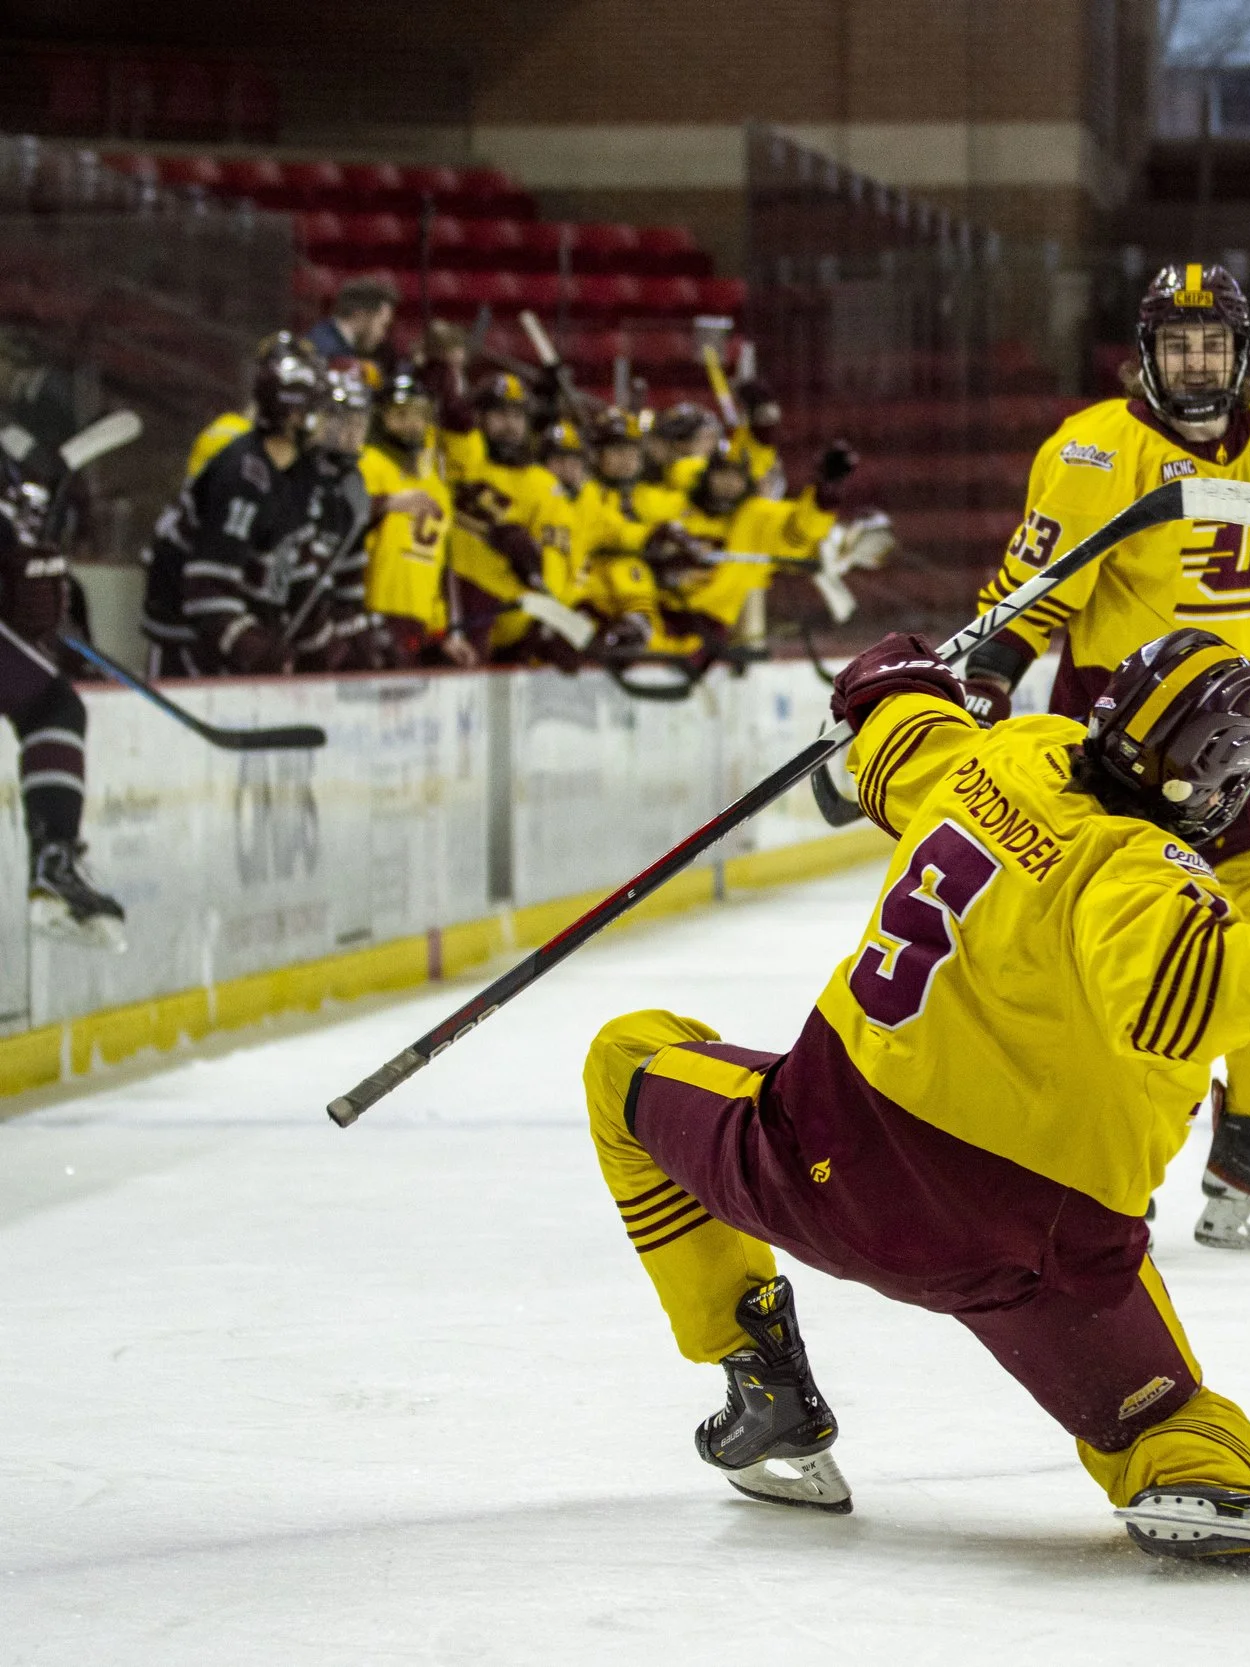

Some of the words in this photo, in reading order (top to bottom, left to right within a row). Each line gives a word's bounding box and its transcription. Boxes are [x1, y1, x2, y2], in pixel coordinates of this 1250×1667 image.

[1162, 459, 1196, 481] MCHC
[946, 757, 1065, 883] PORZONDEK
[849, 817, 1003, 1031] 5
